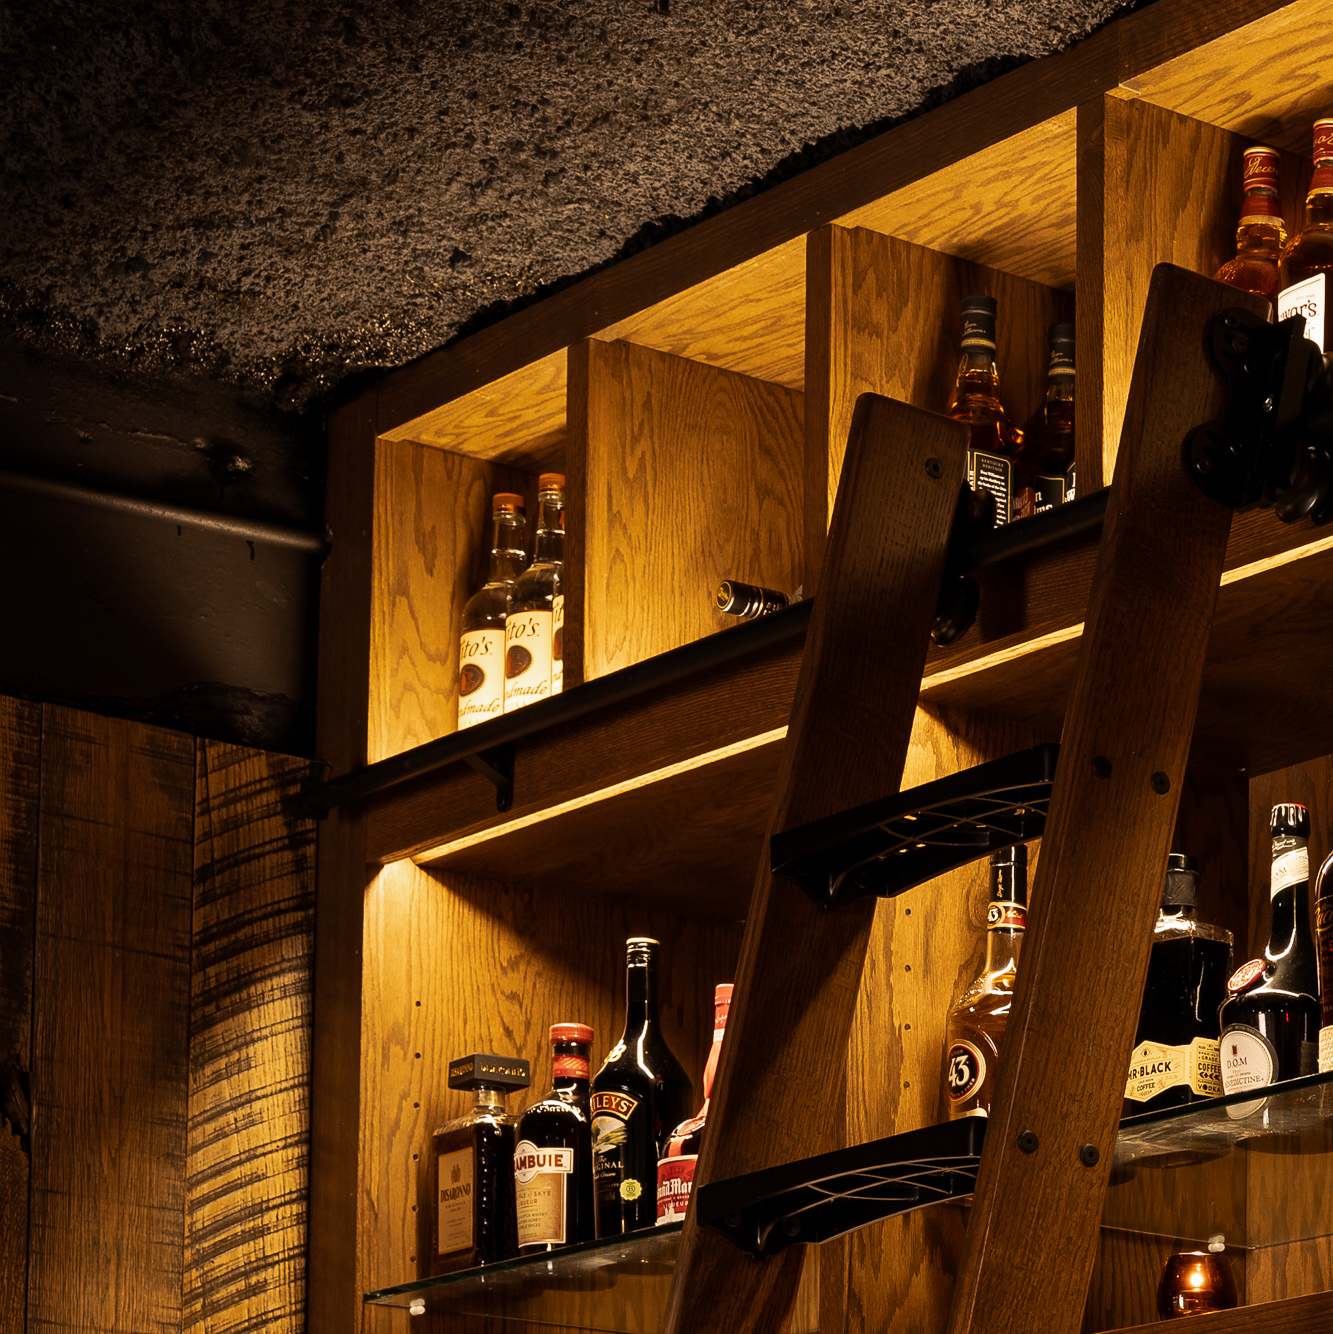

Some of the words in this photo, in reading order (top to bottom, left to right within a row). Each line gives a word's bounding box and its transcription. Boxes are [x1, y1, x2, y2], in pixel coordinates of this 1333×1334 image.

[948, 1054, 970, 1088] 43
[1198, 1062, 1222, 1074] COFFEE
[1136, 1082, 1156, 1092] COFFEE
[1197, 1084, 1221, 1093] VODKA
[592, 1094, 631, 1113] ILEYS
[514, 1154, 564, 1173] AMBUIE
[440, 1183, 471, 1203] DISARONNO
[669, 1177, 692, 1195] Mar
